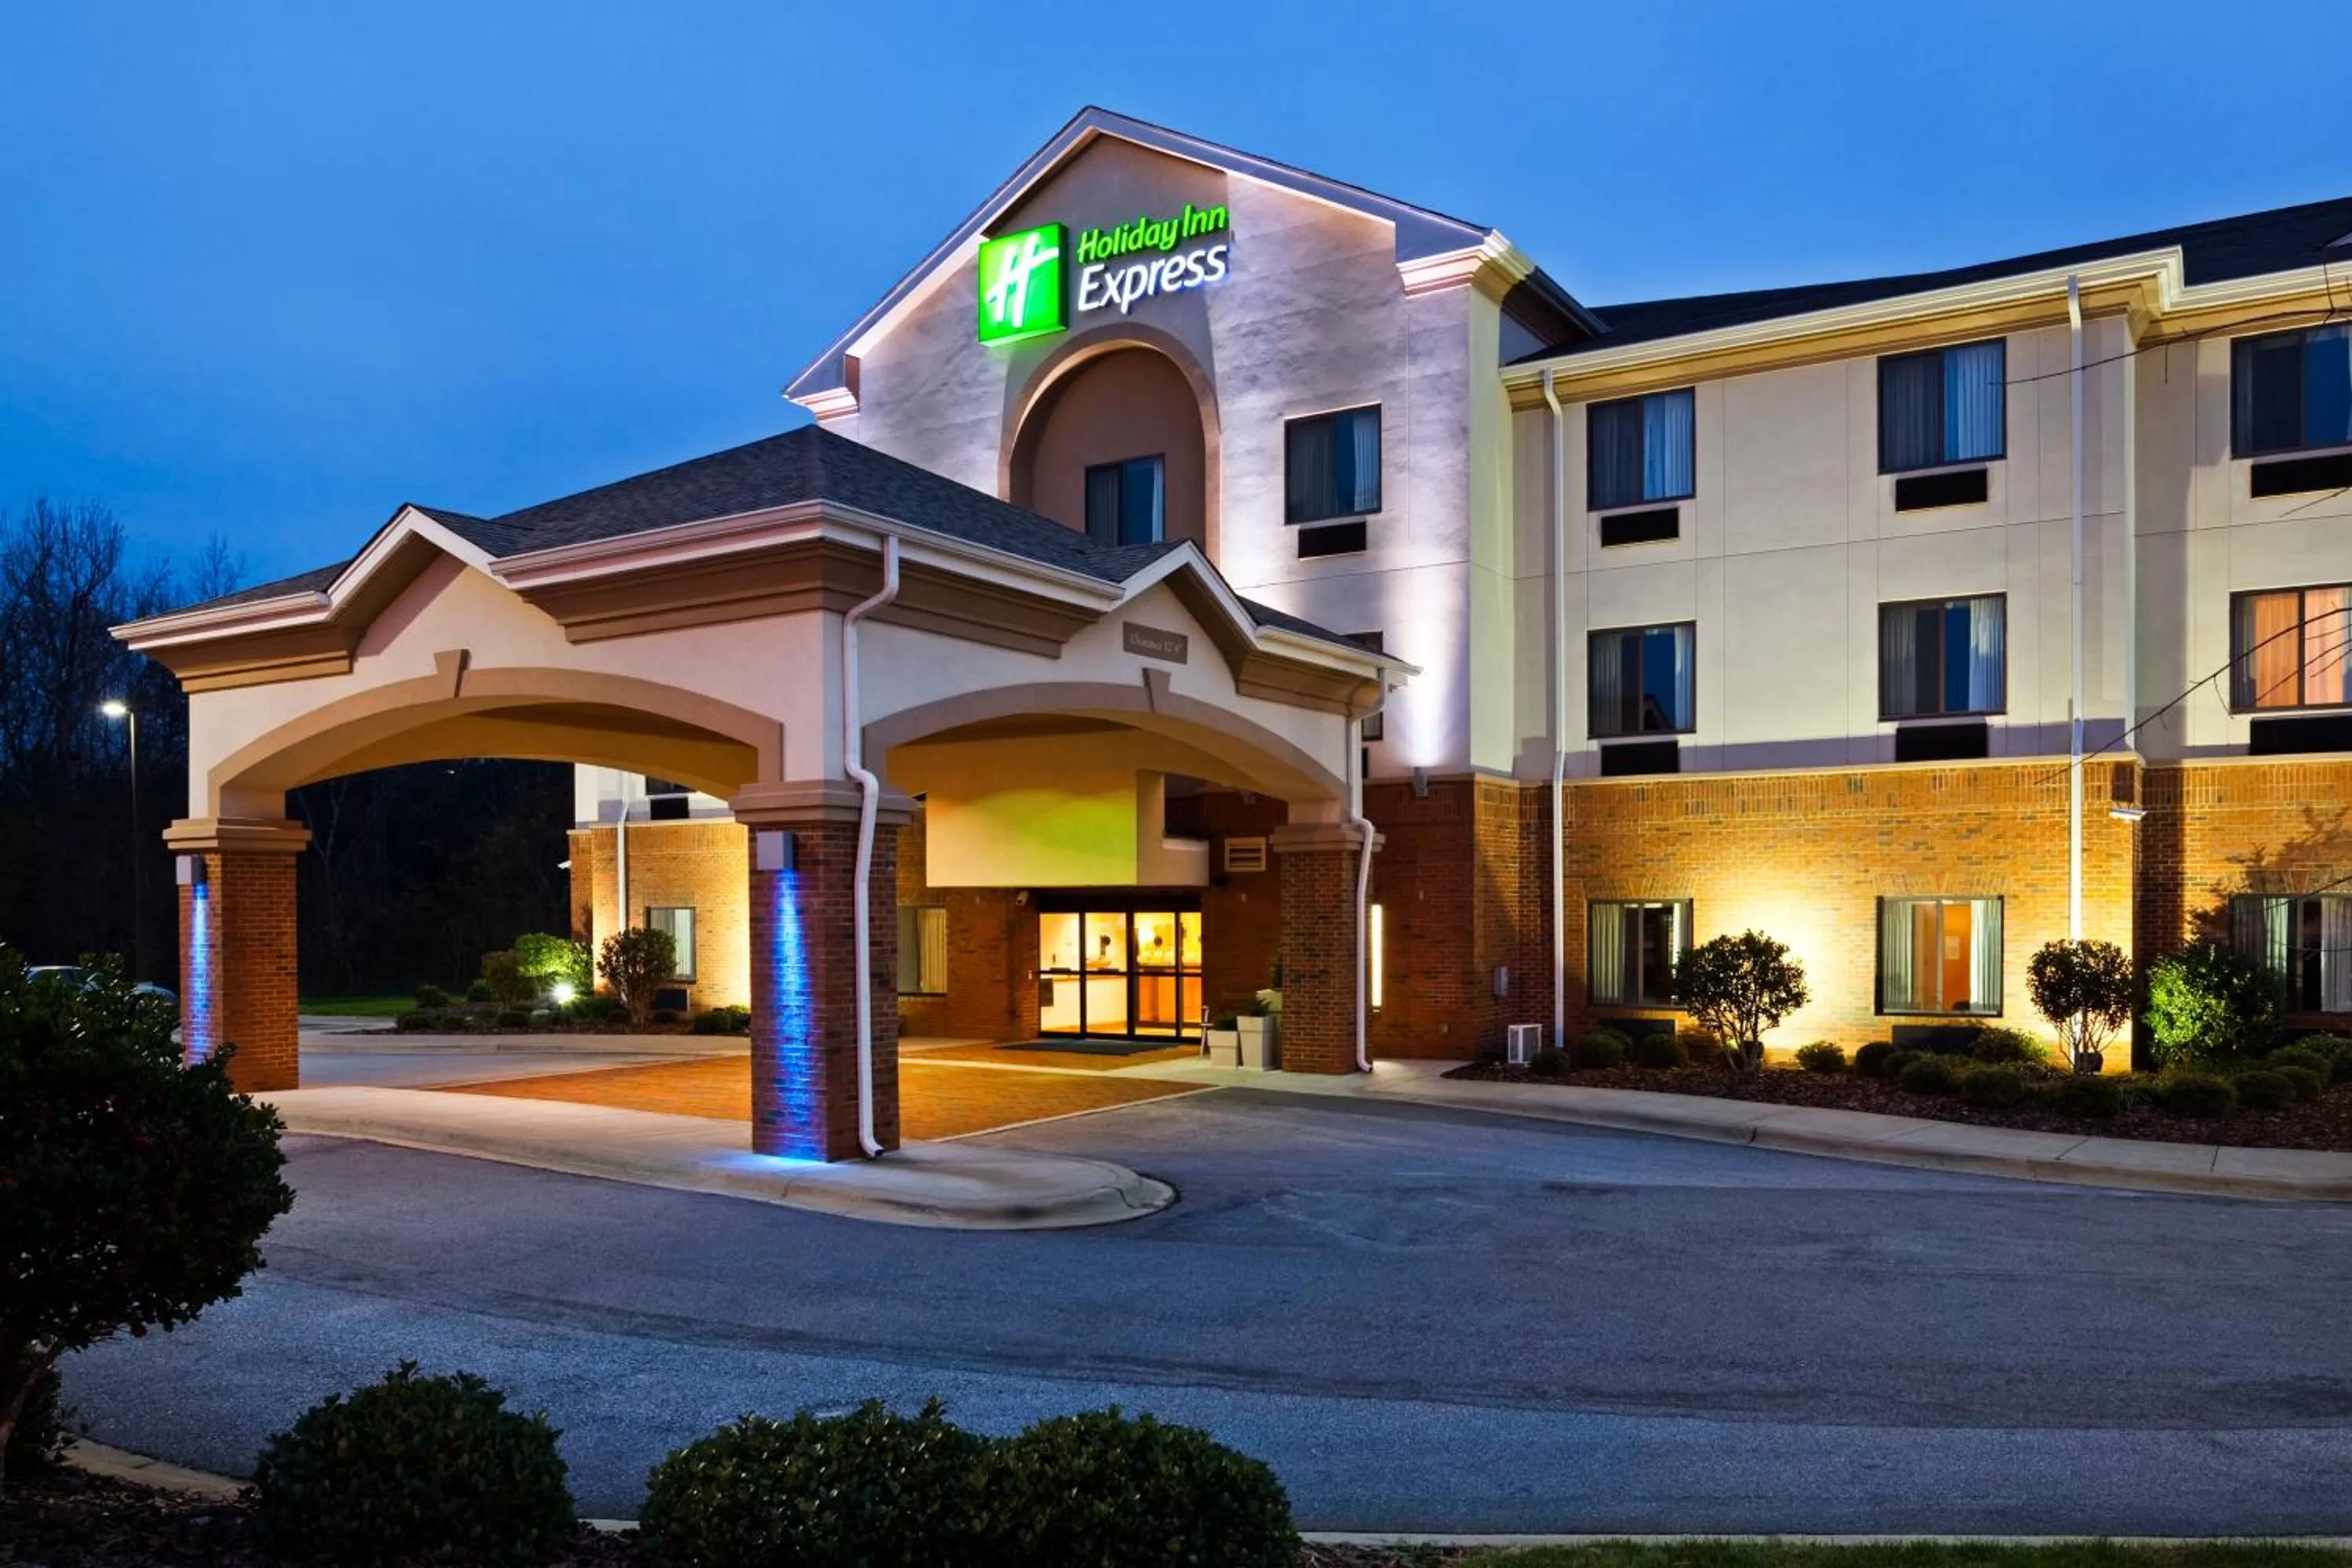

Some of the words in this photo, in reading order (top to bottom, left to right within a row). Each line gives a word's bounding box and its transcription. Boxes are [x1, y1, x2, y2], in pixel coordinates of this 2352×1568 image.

[1078, 216, 1178, 263] Holiday
[1182, 204, 1226, 238] Inn
[1077, 245, 1228, 314] Express
